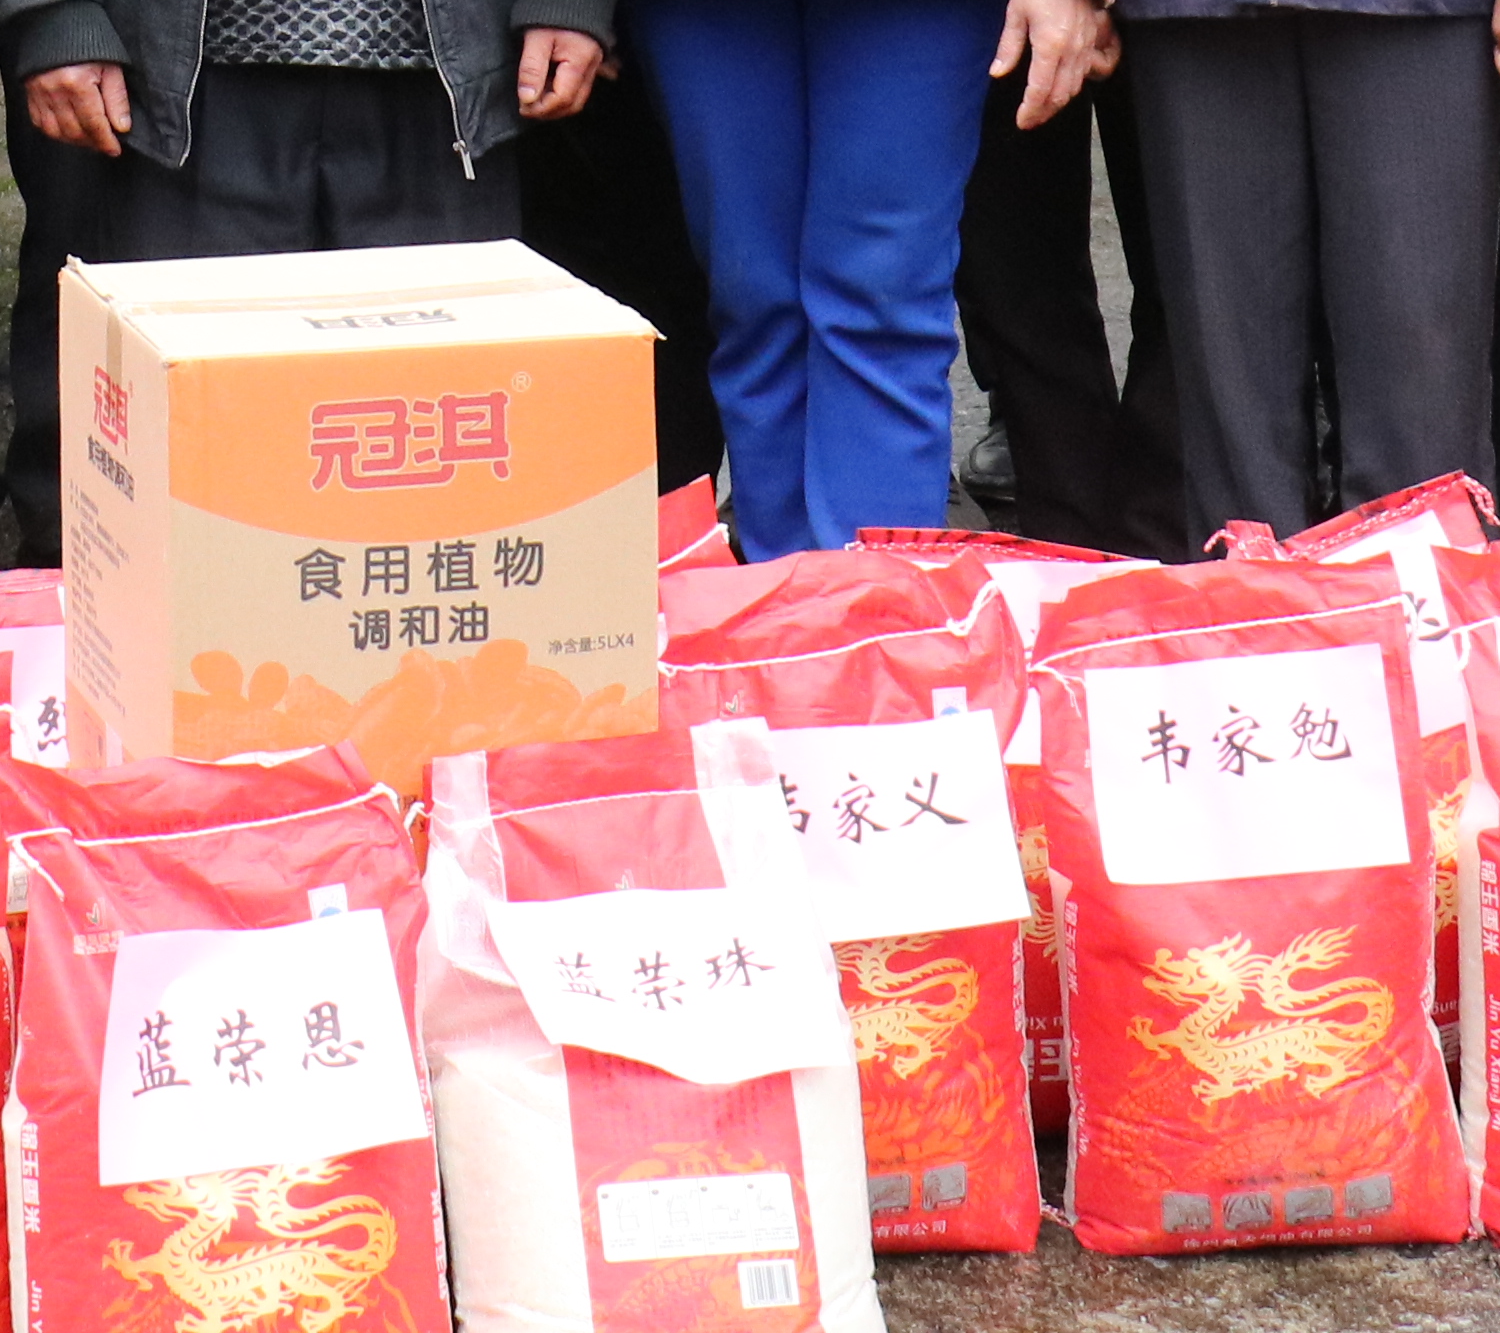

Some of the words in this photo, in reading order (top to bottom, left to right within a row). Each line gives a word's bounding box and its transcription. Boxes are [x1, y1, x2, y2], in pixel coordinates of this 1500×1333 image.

[293, 536, 546, 602] 食用植物
[347, 600, 491, 651] 调和油
[1140, 702, 1353, 785] 韦家勉
[555, 936, 777, 1012] 蓝荣珠
[132, 1001, 365, 1100] 蓝荣恩
[30, 1279, 43, 1313] Jin
